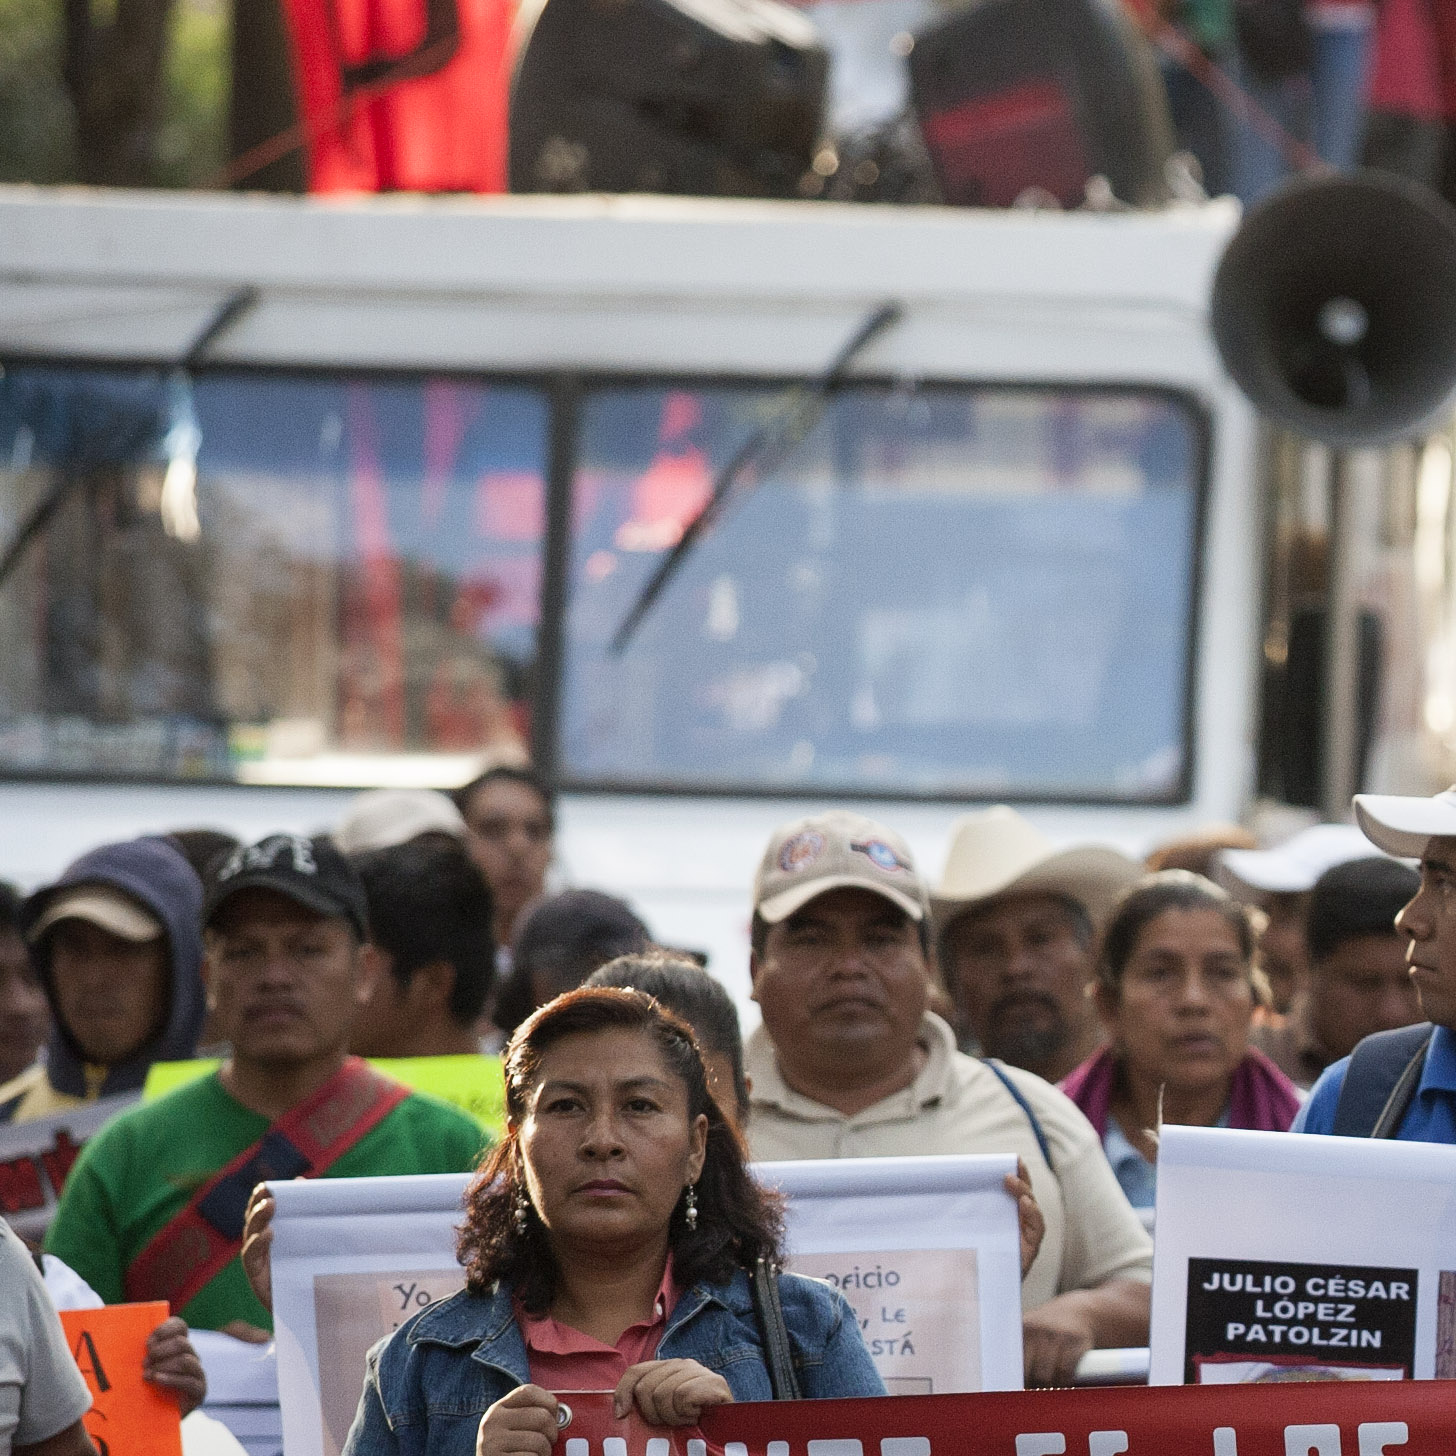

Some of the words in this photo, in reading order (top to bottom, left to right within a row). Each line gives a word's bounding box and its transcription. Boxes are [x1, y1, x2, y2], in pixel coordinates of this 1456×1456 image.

[393, 1282, 432, 1310] Yo
[1203, 1272, 1296, 1294] JULIO
[1304, 1274, 1410, 1301] CÉSAR
[881, 1306, 907, 1323] LE
[1255, 1296, 1356, 1323] LÓPEZ
[865, 1330, 915, 1356] STÁ
[1225, 1322, 1382, 1348] PATOLZIN
